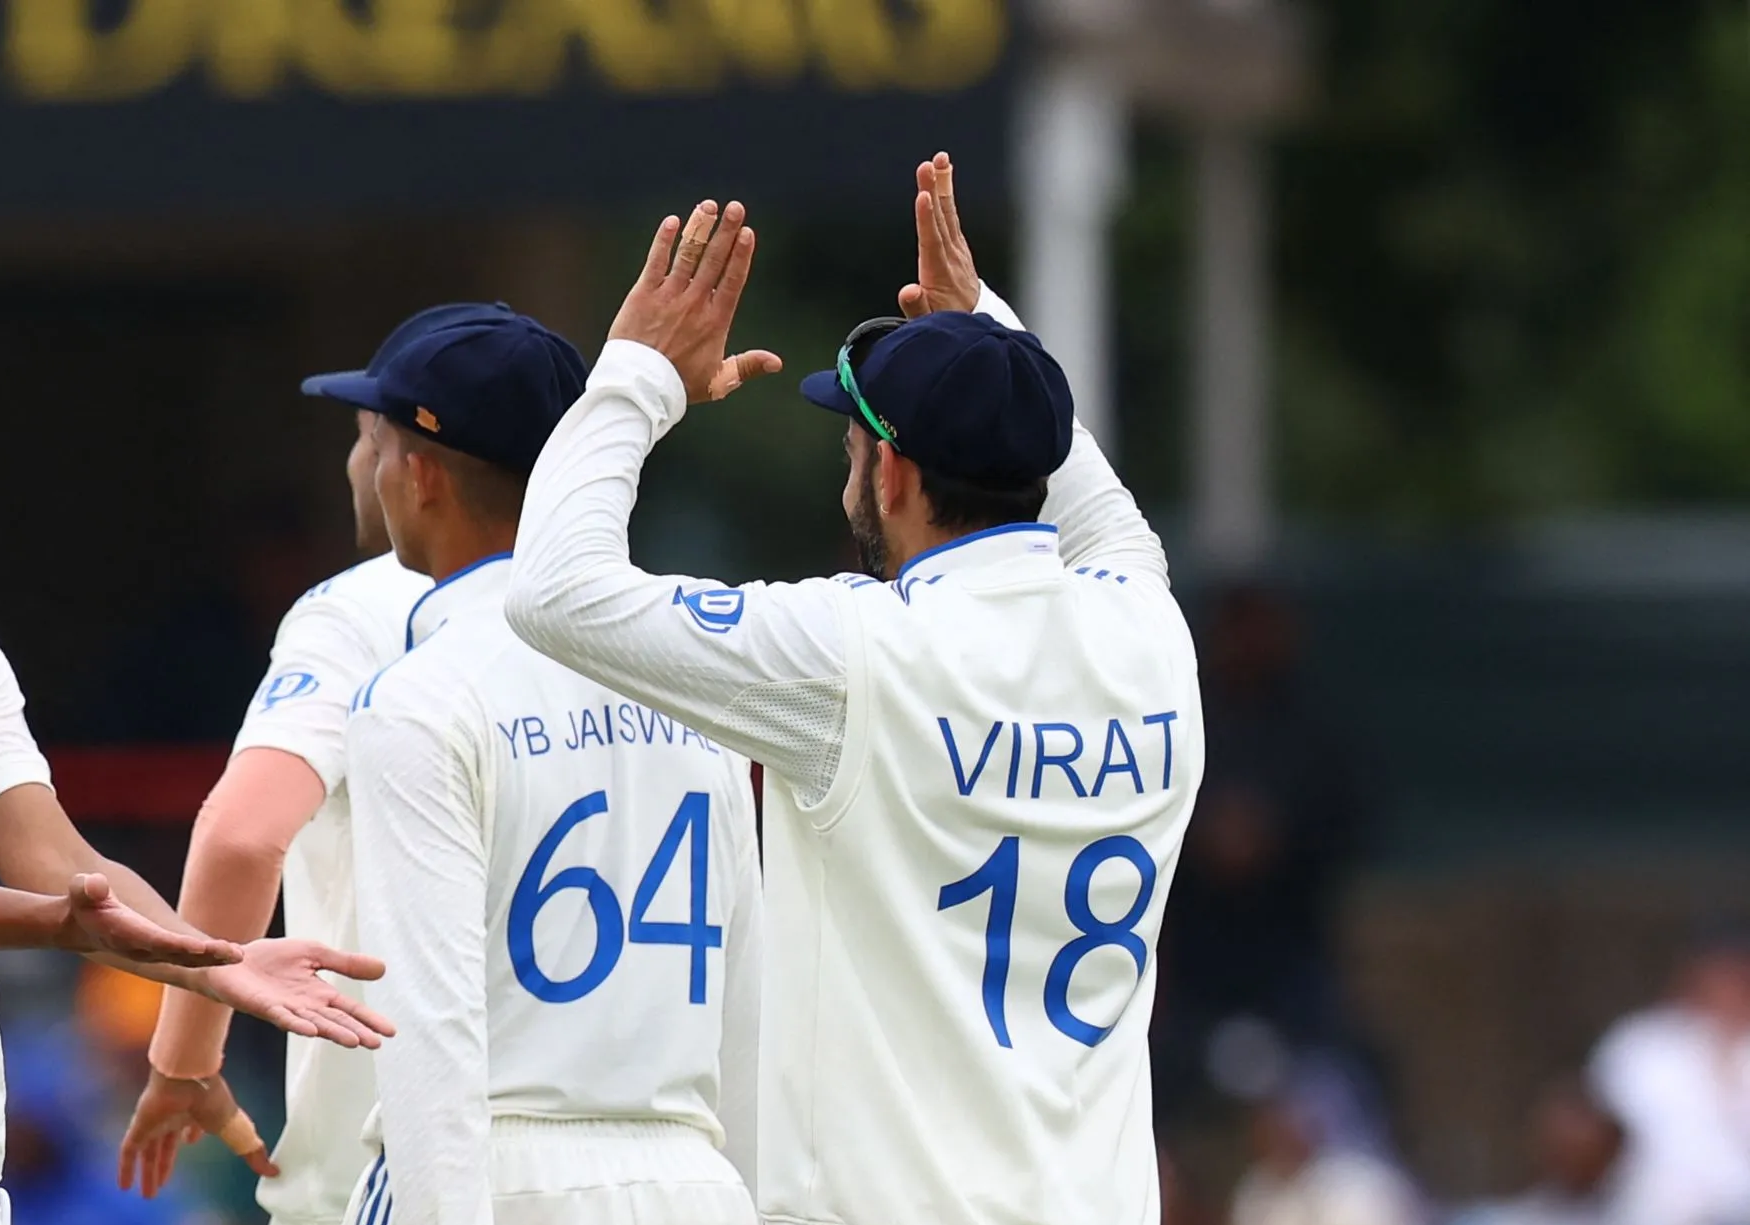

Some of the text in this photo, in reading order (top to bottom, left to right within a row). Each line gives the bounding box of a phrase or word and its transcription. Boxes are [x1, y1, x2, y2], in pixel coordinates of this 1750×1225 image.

[2, 0, 1008, 100] DREAMS
[497, 716, 550, 759] YB
[937, 710, 1178, 798] VIRAT
[507, 789, 722, 1005] 64
[937, 835, 1157, 1049] 18
